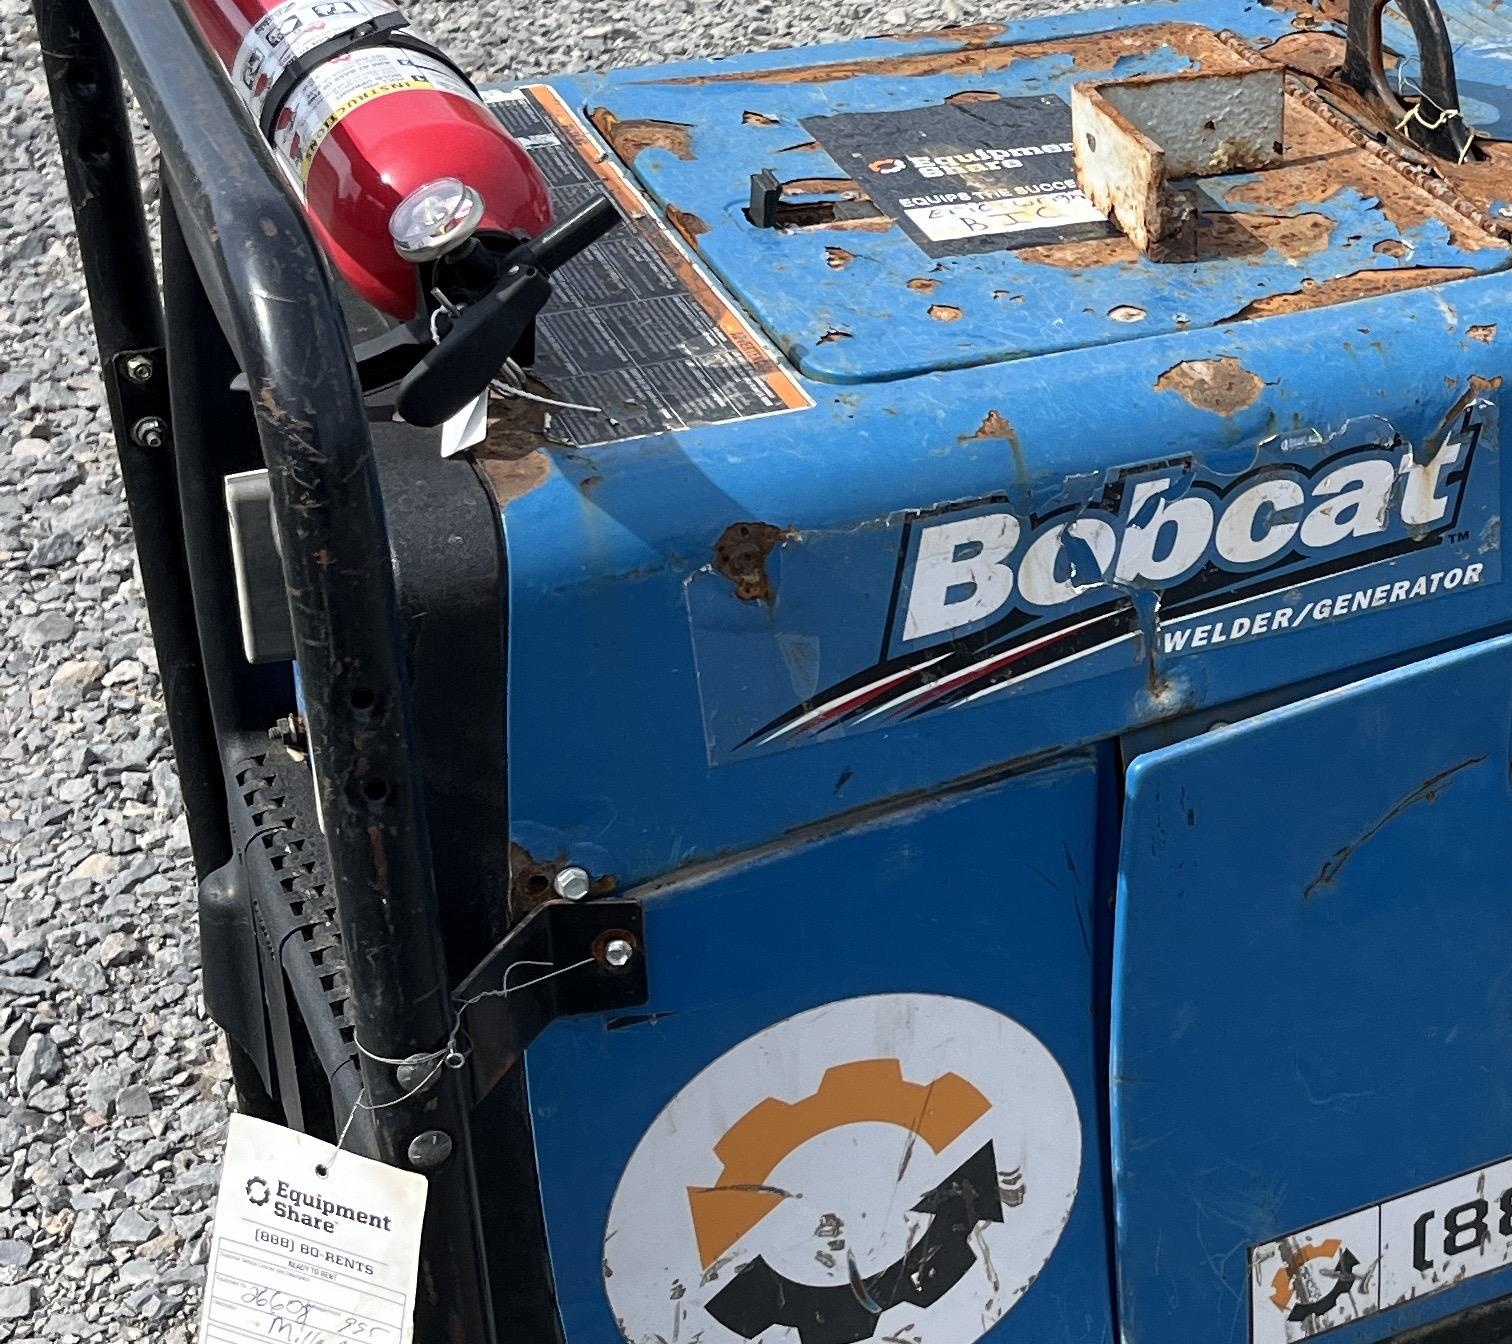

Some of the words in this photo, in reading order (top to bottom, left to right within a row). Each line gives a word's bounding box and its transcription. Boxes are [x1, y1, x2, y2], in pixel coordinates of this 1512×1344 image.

[908, 142, 1074, 168] Equipmen
[917, 158, 1024, 179] Share
[899, 191, 972, 209] EQUIPS
[971, 188, 1009, 204] THE
[1013, 179, 1077, 195] SUCCE
[902, 429, 1465, 642] Bobcat
[1162, 562, 1485, 654] WELDER/GENERATOR
[273, 1200, 336, 1234] Share
[276, 1179, 392, 1232] Equipment
[255, 1228, 295, 1253] (888)
[300, 1243, 374, 1276] 80-RENTS
[310, 1266, 320, 1276] TO
